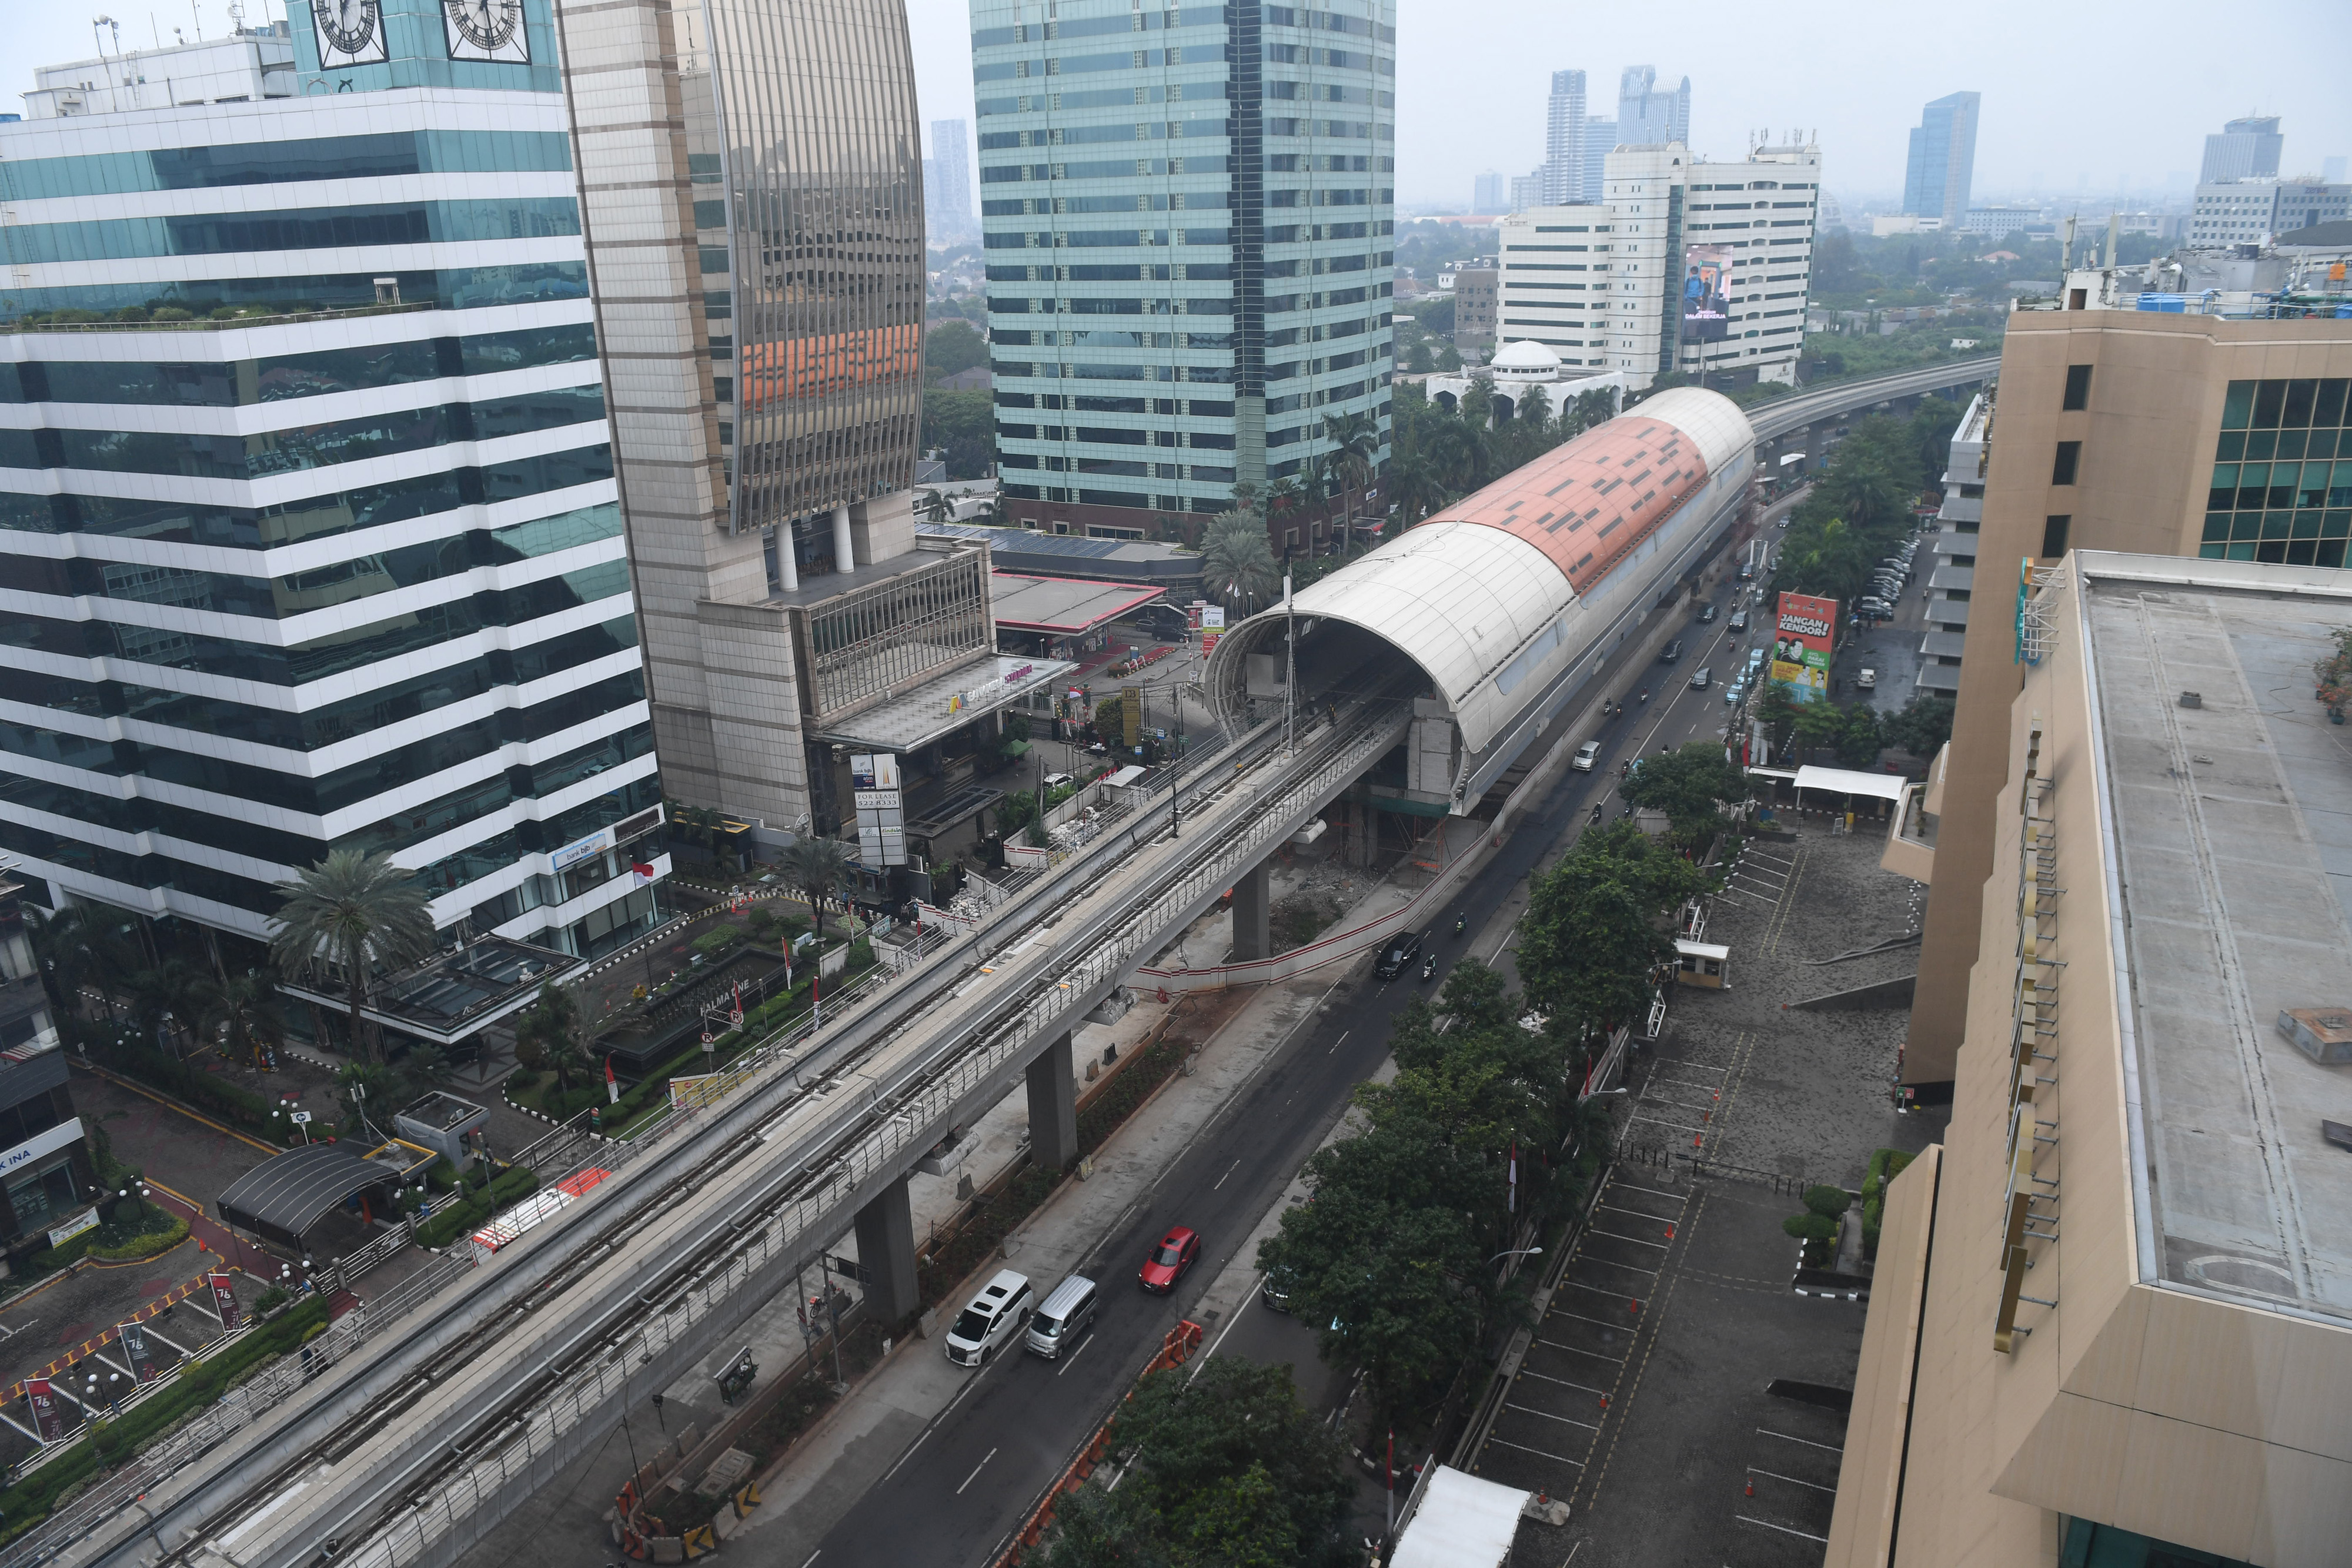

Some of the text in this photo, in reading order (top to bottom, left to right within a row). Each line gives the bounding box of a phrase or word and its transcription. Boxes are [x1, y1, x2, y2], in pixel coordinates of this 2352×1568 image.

[1780, 614, 1823, 628] JANGAN
[1779, 621, 1830, 636] KENDOR!
[1005, 663, 1033, 684] SYARIAH
[567, 850, 580, 861] bank
[580, 844, 590, 854] bjb
[9, 1150, 31, 1165] INA
[216, 1288, 231, 1299] 76
[128, 1339, 143, 1350] 76
[34, 1396, 50, 1407] 76
